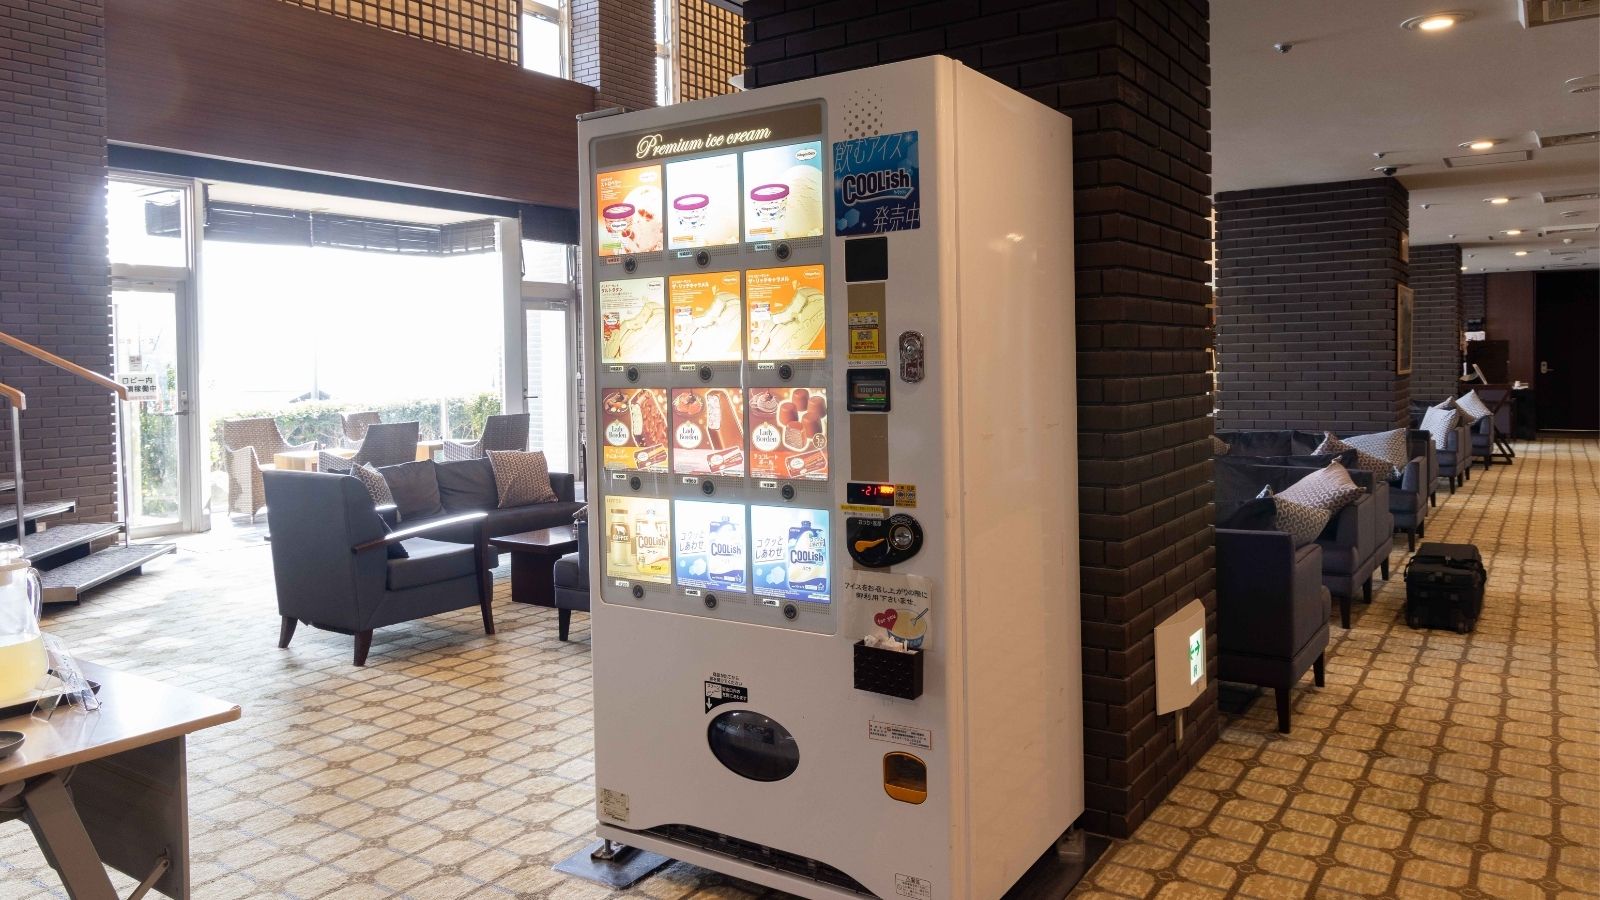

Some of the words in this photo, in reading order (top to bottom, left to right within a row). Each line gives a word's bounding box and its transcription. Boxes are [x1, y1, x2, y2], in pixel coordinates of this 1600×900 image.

[635, 133, 704, 159] Premium
[705, 133, 725, 148] ice
[726, 127, 772, 145] cream
[833, 134, 904, 174] 飲むアイス
[842, 168, 912, 206] COOLish
[873, 202, 920, 233] 発売中
[611, 425, 625, 434] Lady
[682, 426, 696, 436] Lady
[758, 428, 774, 437] Lady
[679, 433, 699, 441] Borden
[755, 434, 778, 443] Borden
[637, 536, 667, 548] COOLish
[679, 541, 705, 552] しあわせ
[756, 536, 783, 548] コクッと
[711, 542, 742, 557] COOLish
[755, 547, 783, 560] しあわせ
[790, 550, 824, 565] COOLish
